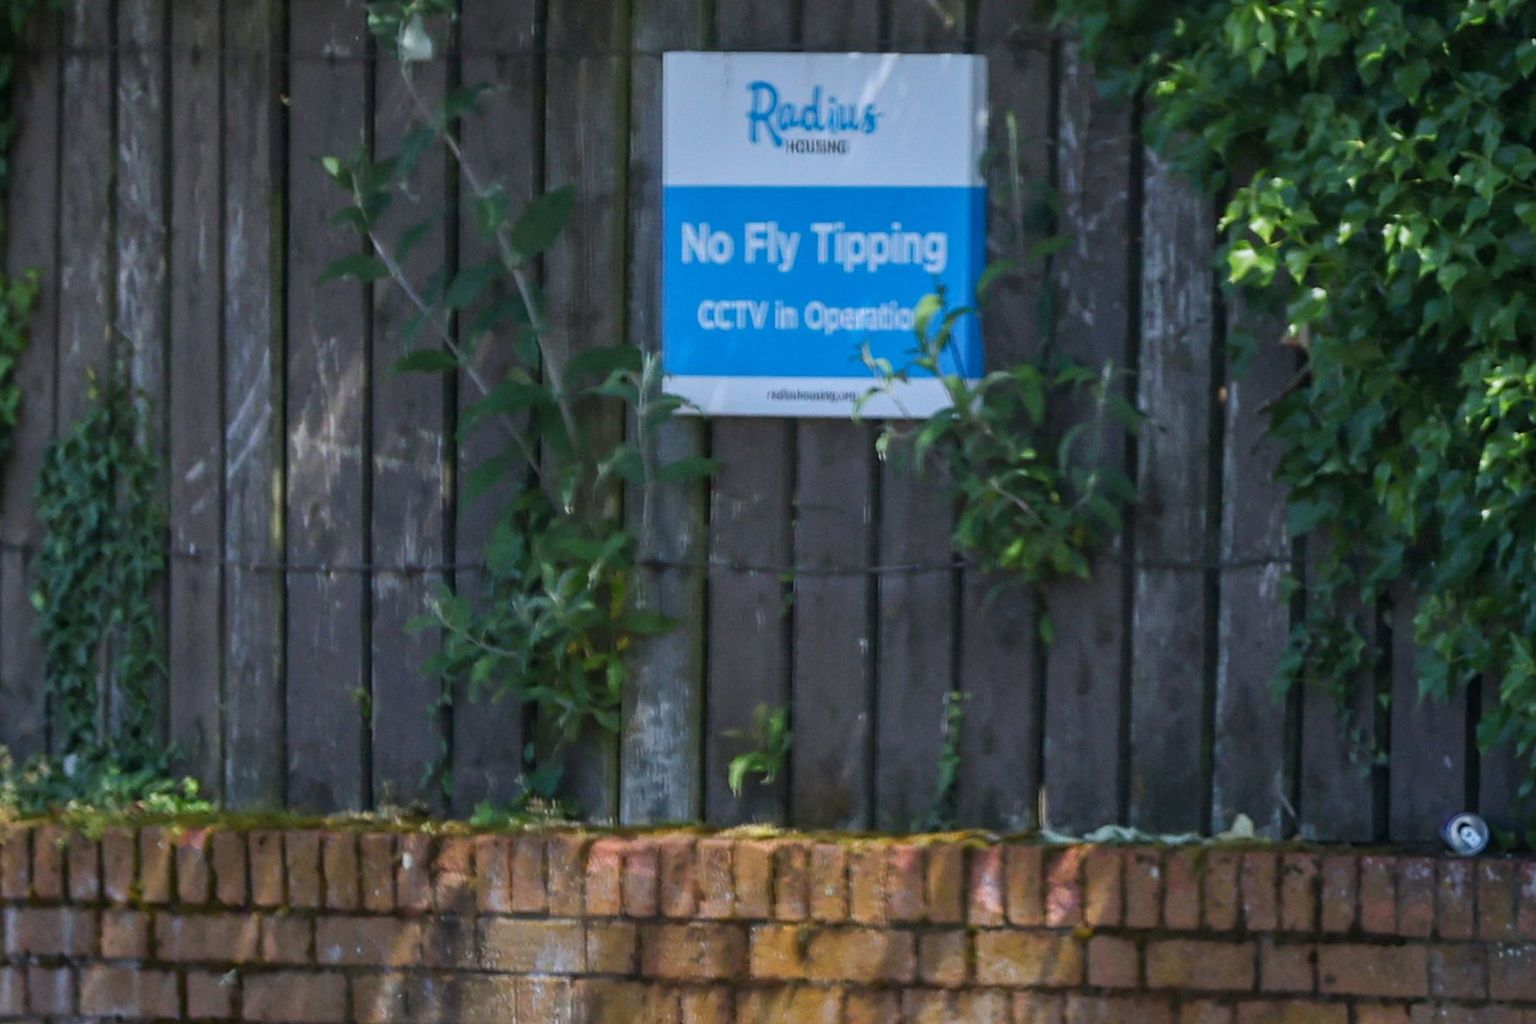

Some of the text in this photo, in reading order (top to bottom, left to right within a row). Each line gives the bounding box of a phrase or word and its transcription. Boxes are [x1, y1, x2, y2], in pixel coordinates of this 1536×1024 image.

[746, 80, 882, 147] Radius
[785, 140, 849, 154] HOUSING
[680, 222, 948, 274] No Fly Tipping
[698, 300, 916, 335] CCTV in Operatio
